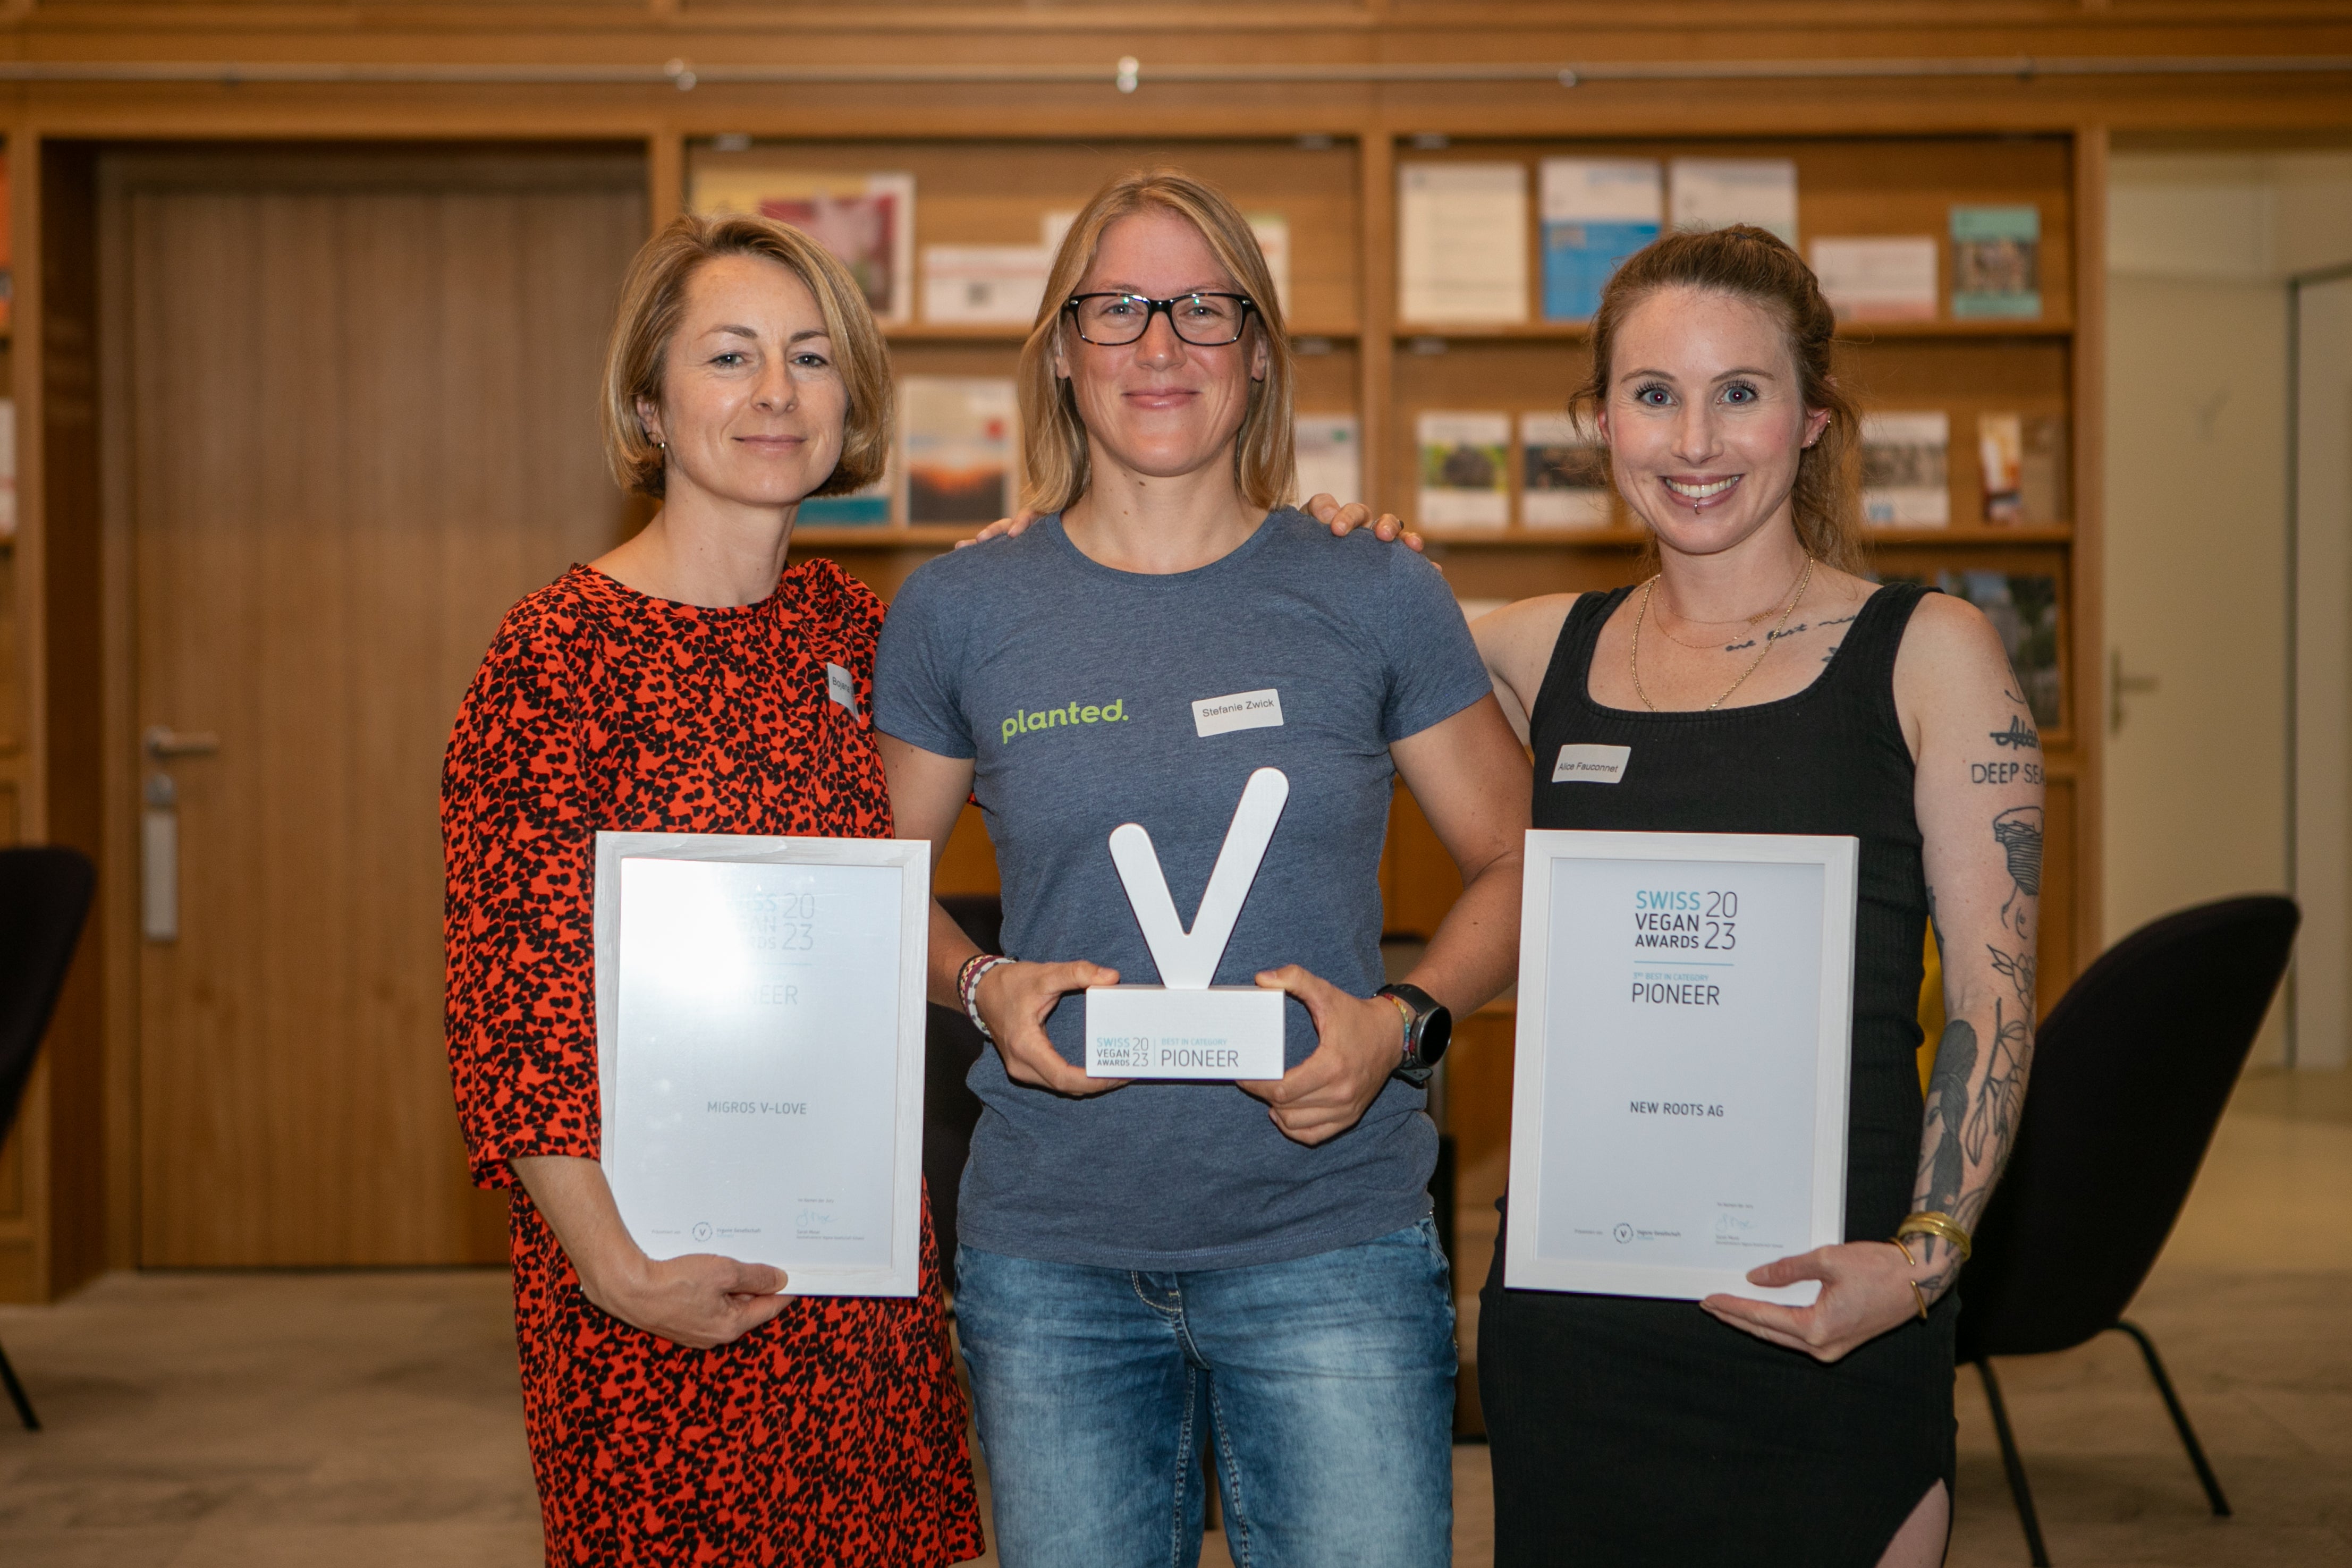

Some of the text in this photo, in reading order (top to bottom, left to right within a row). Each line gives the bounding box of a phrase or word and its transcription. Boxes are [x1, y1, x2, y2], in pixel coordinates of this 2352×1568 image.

[1202, 699, 1274, 717] Stefanie Zwick
[1002, 699, 1129, 744] planted.
[1558, 762, 1619, 773] Alice Fauconnet
[1972, 762, 2019, 784] DEEP
[783, 893, 815, 919] 20
[1636, 890, 1700, 911] SWISS
[1706, 891, 1737, 918] 20
[1635, 912, 1699, 932] VEGAN
[782, 922, 814, 951] 23
[1635, 934, 1699, 949] AWARDS
[1705, 921, 1736, 950] 23
[1673, 973, 1709, 982] CATEGORY
[1632, 983, 1720, 1006] PIONEER
[1097, 1037, 1130, 1048] SWISS
[1132, 1037, 1149, 1052] 20
[1190, 1038, 1227, 1046] CATEGORY
[1097, 1049, 1130, 1058] VEGAN
[1132, 1052, 1149, 1067] 23
[1161, 1049, 1239, 1067] PIONEER
[707, 1101, 807, 1115] MIGROS V-LOVE
[1630, 1100, 1724, 1117] NEW ROOTS AG
